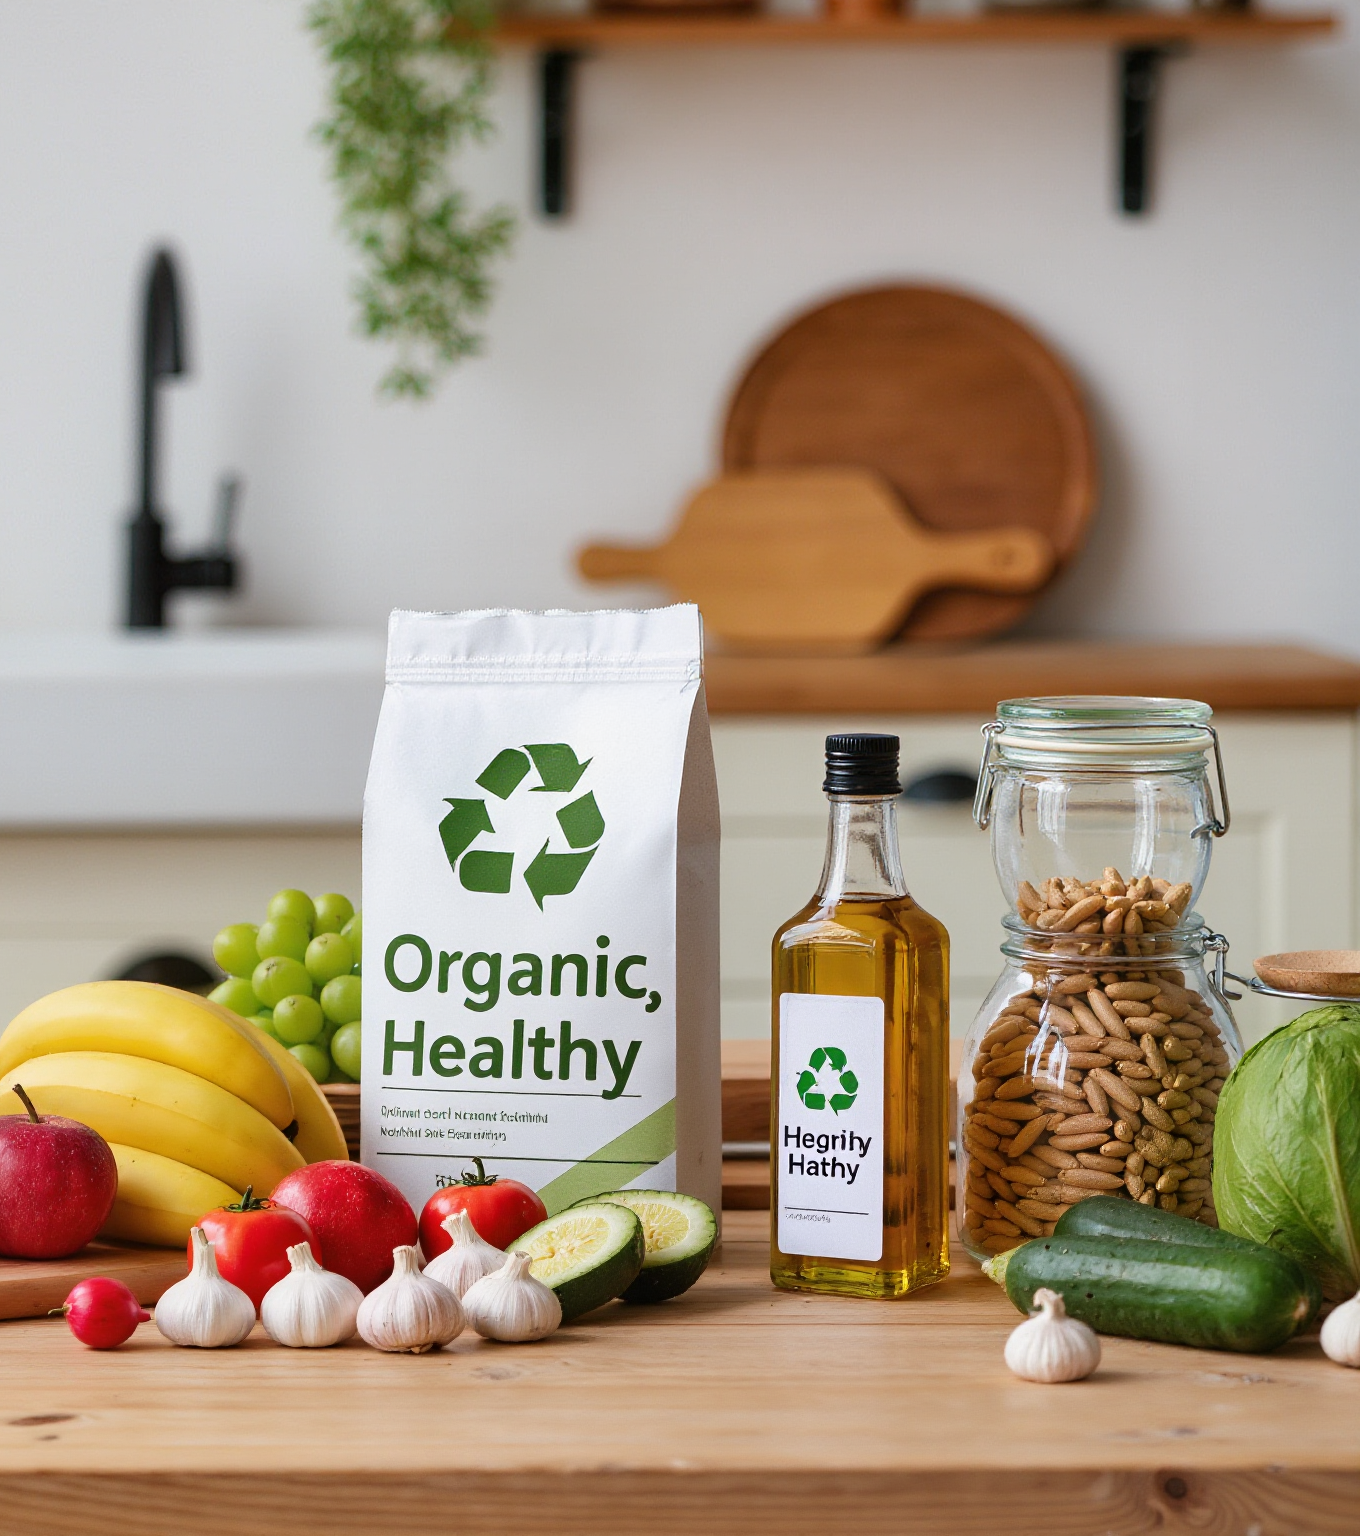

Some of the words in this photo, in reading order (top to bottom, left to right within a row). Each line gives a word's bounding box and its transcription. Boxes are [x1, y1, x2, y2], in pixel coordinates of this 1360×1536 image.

[384, 933, 662, 1013] Organic,
[382, 1019, 643, 1100] Healthy
[788, 1153, 860, 1185] Hathy
